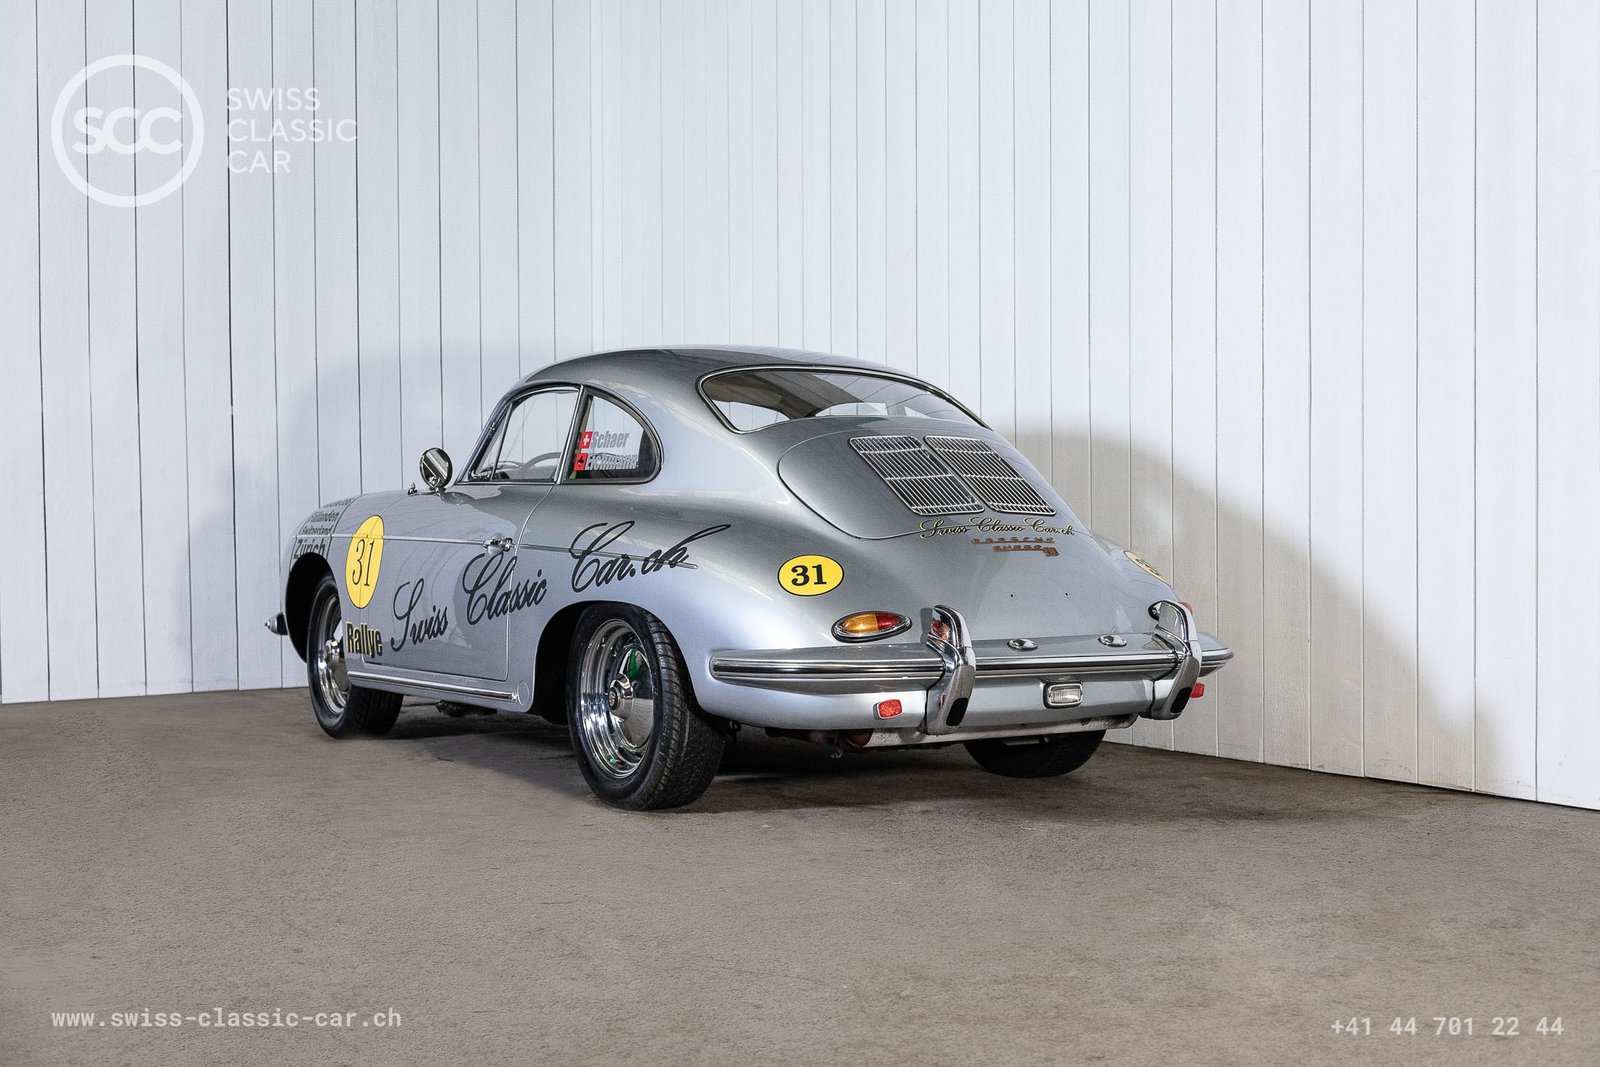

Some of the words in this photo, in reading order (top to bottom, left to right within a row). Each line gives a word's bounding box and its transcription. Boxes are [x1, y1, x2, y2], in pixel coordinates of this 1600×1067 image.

[590, 430, 630, 449] Schaer
[920, 518, 968, 539] Swiss
[969, 516, 1024, 532] Classic
[293, 537, 326, 560] Zürich
[352, 538, 375, 587] 31
[391, 578, 449, 651] Swiss
[462, 549, 547, 626] Classic
[568, 520, 732, 593] Car.ch
[791, 563, 827, 587] 31
[345, 620, 383, 659] Rallye
